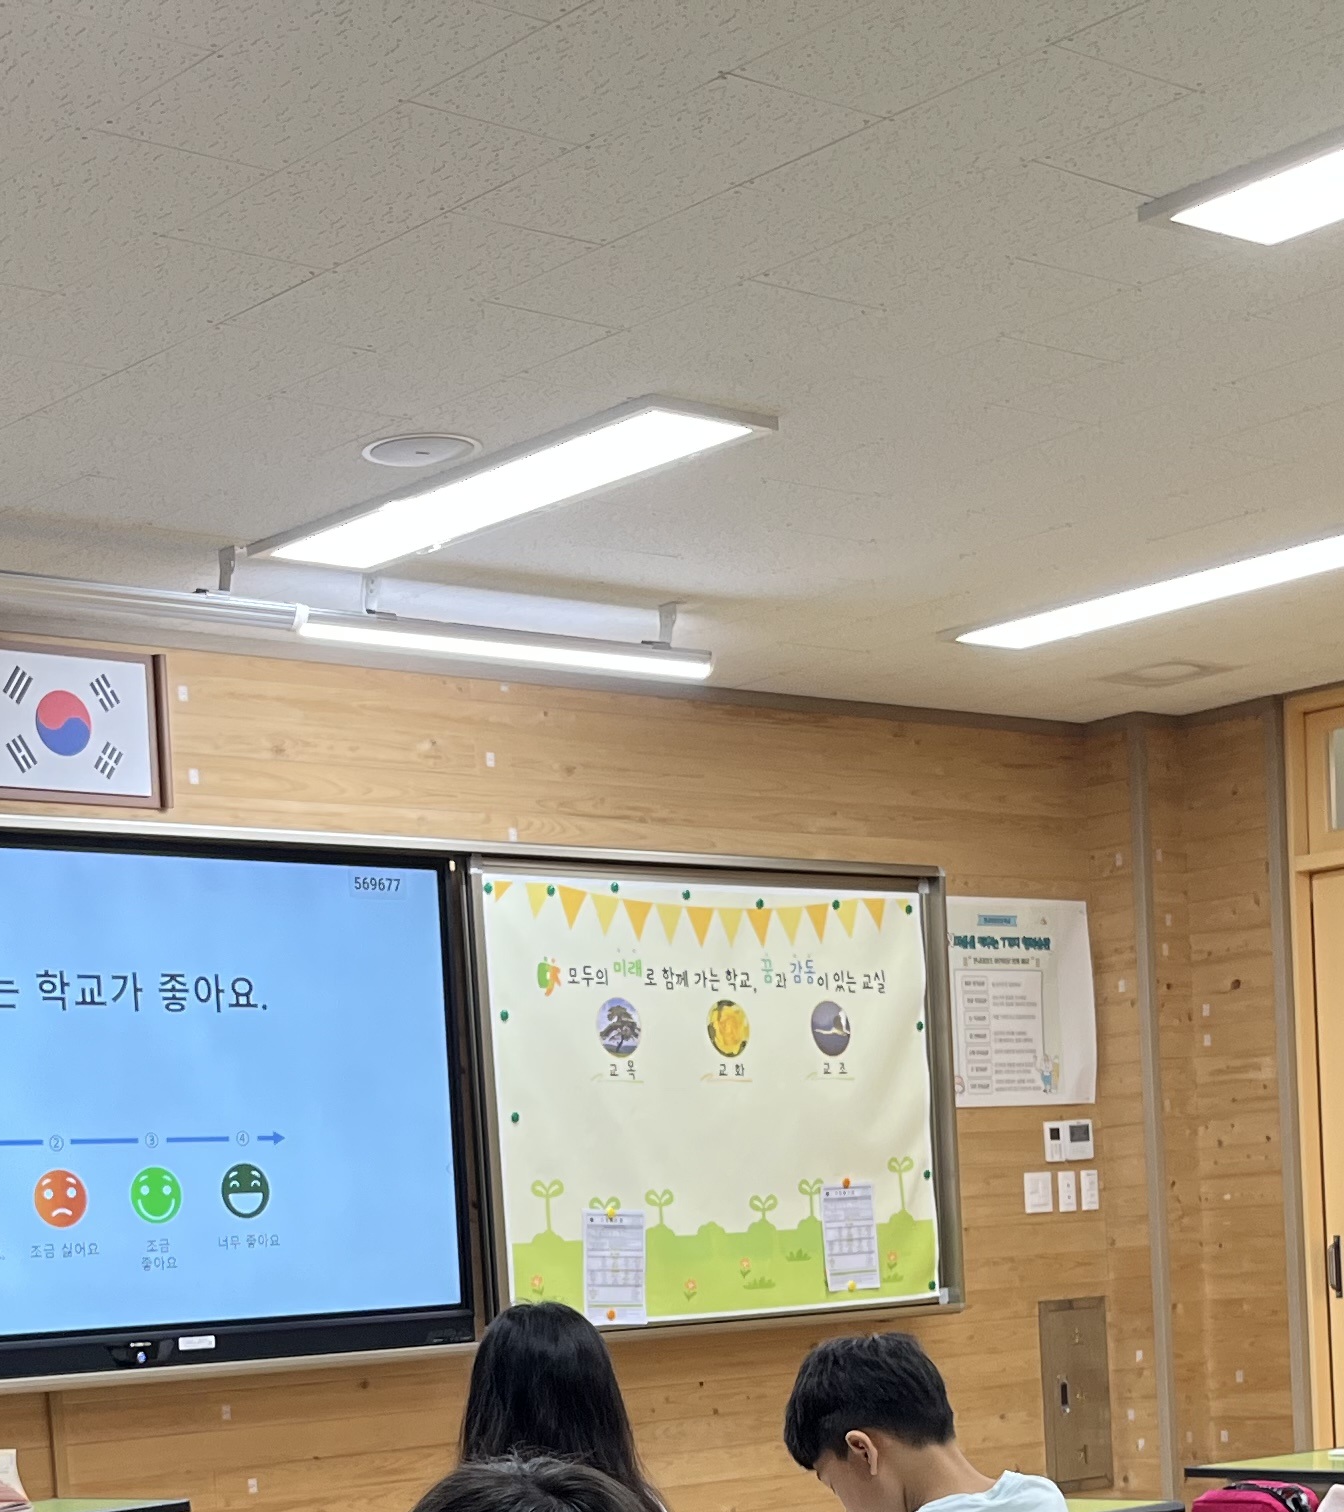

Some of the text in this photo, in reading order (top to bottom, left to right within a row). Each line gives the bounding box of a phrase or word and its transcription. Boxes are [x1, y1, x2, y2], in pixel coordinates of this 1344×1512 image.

[354, 876, 401, 892] 569677
[567, 965, 609, 988] 모두의
[661, 966, 689, 991] 함께
[694, 967, 721, 992] 가는
[725, 968, 757, 994] 학교,
[833, 970, 857, 994] 있는
[862, 970, 886, 994] 교실
[35, 969, 144, 1012] 학교가
[158, 972, 268, 1013] 좋아요.
[146, 1237, 171, 1254] 조금
[217, 1233, 281, 1250] 너무 좋아요
[30, 1243, 55, 1260] 조금
[140, 1255, 178, 1272] 좋아요
